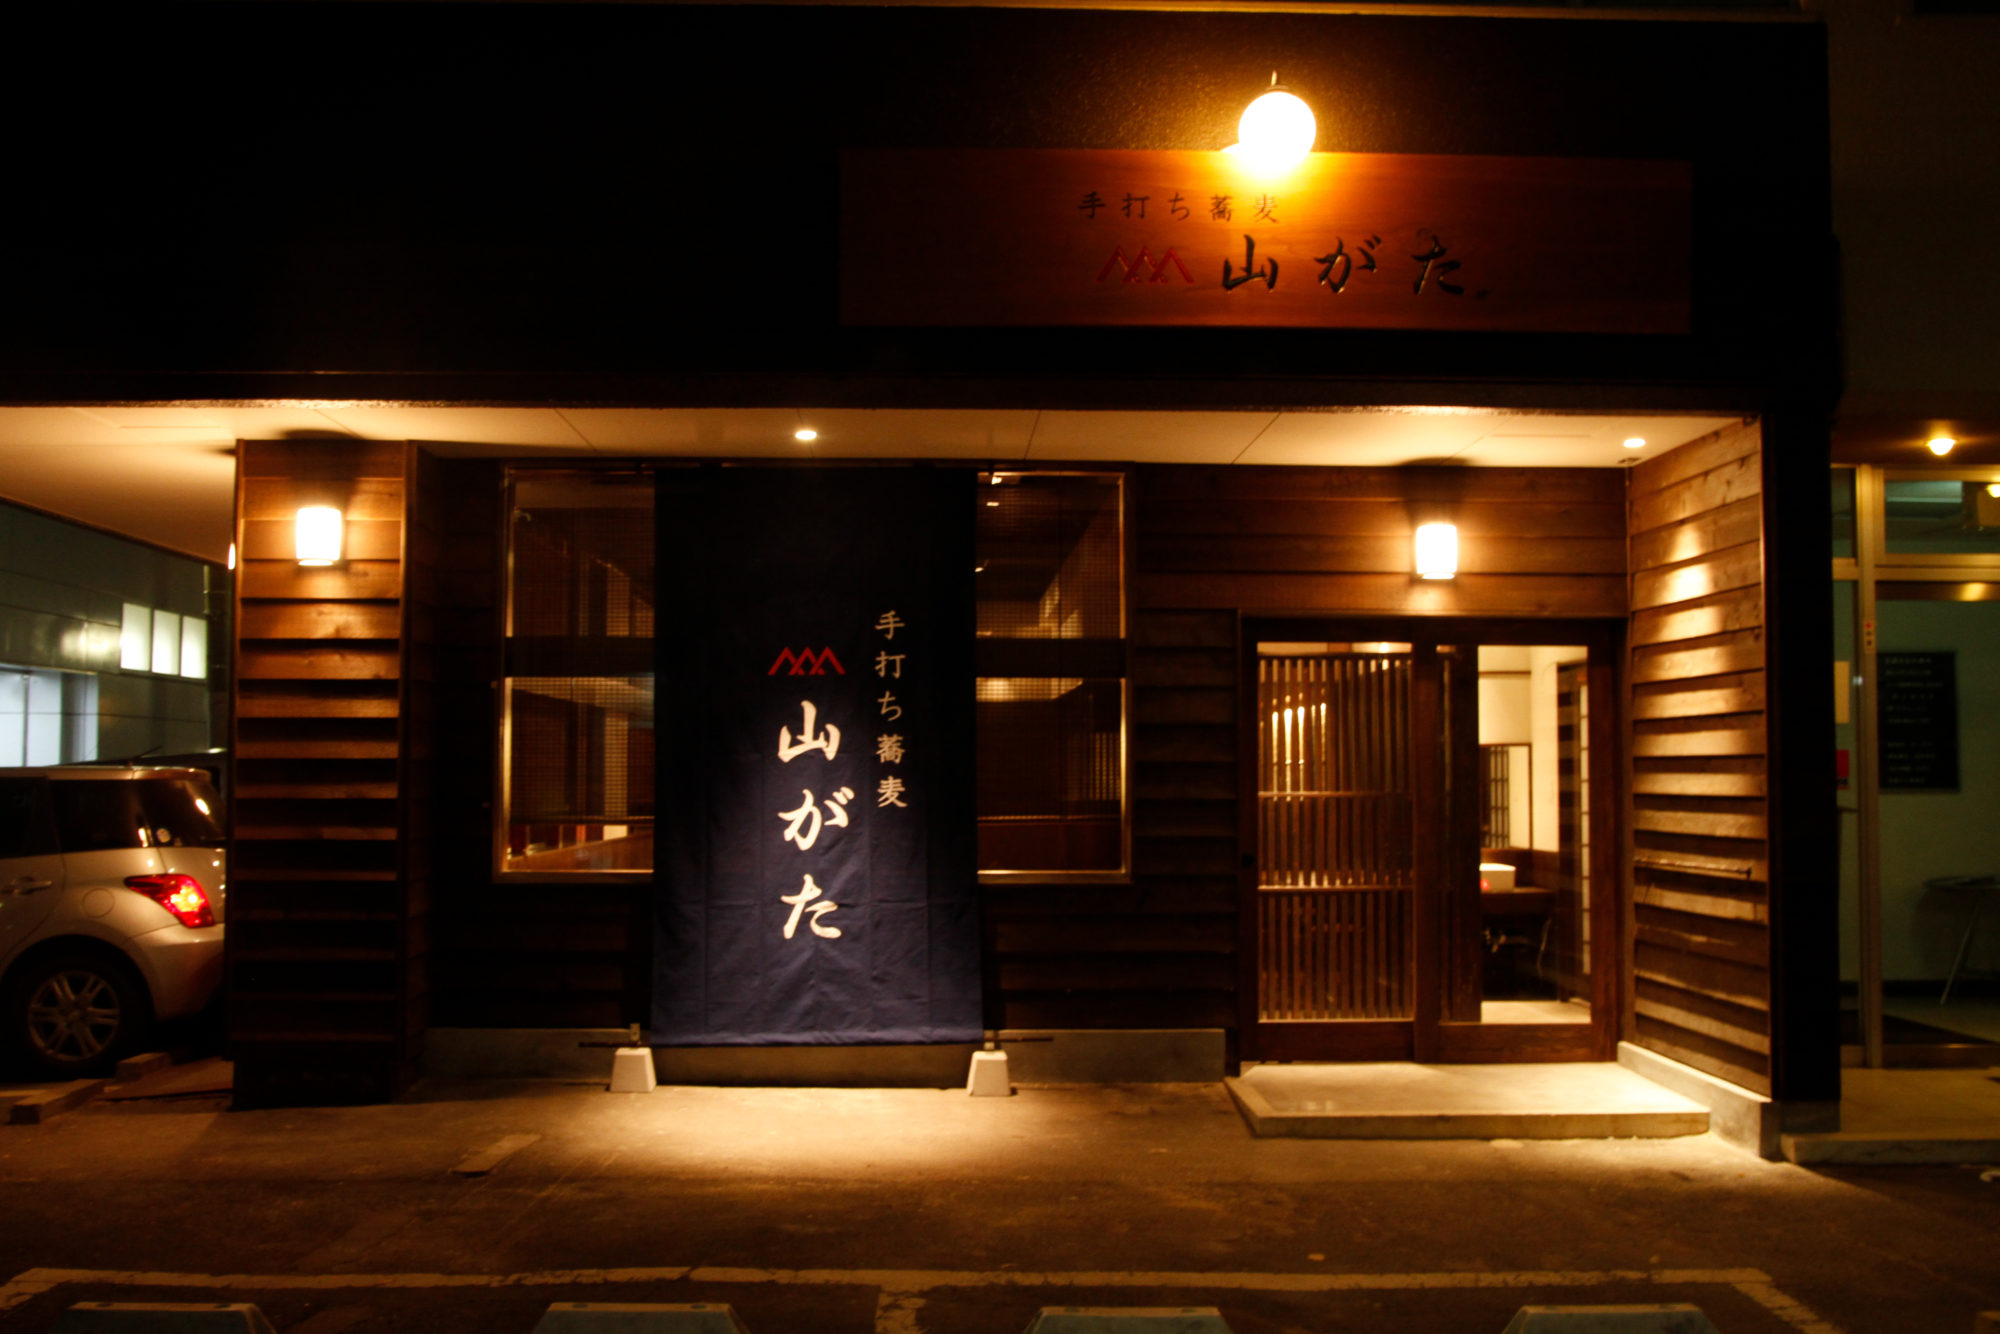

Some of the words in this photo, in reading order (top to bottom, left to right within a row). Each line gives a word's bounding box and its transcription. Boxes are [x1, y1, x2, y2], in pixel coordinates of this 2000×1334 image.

[1078, 191, 1279, 223] 手打ち蕎麦
[874, 609, 909, 808] 手打ち蕎麦
[777, 699, 855, 940] 山がた
